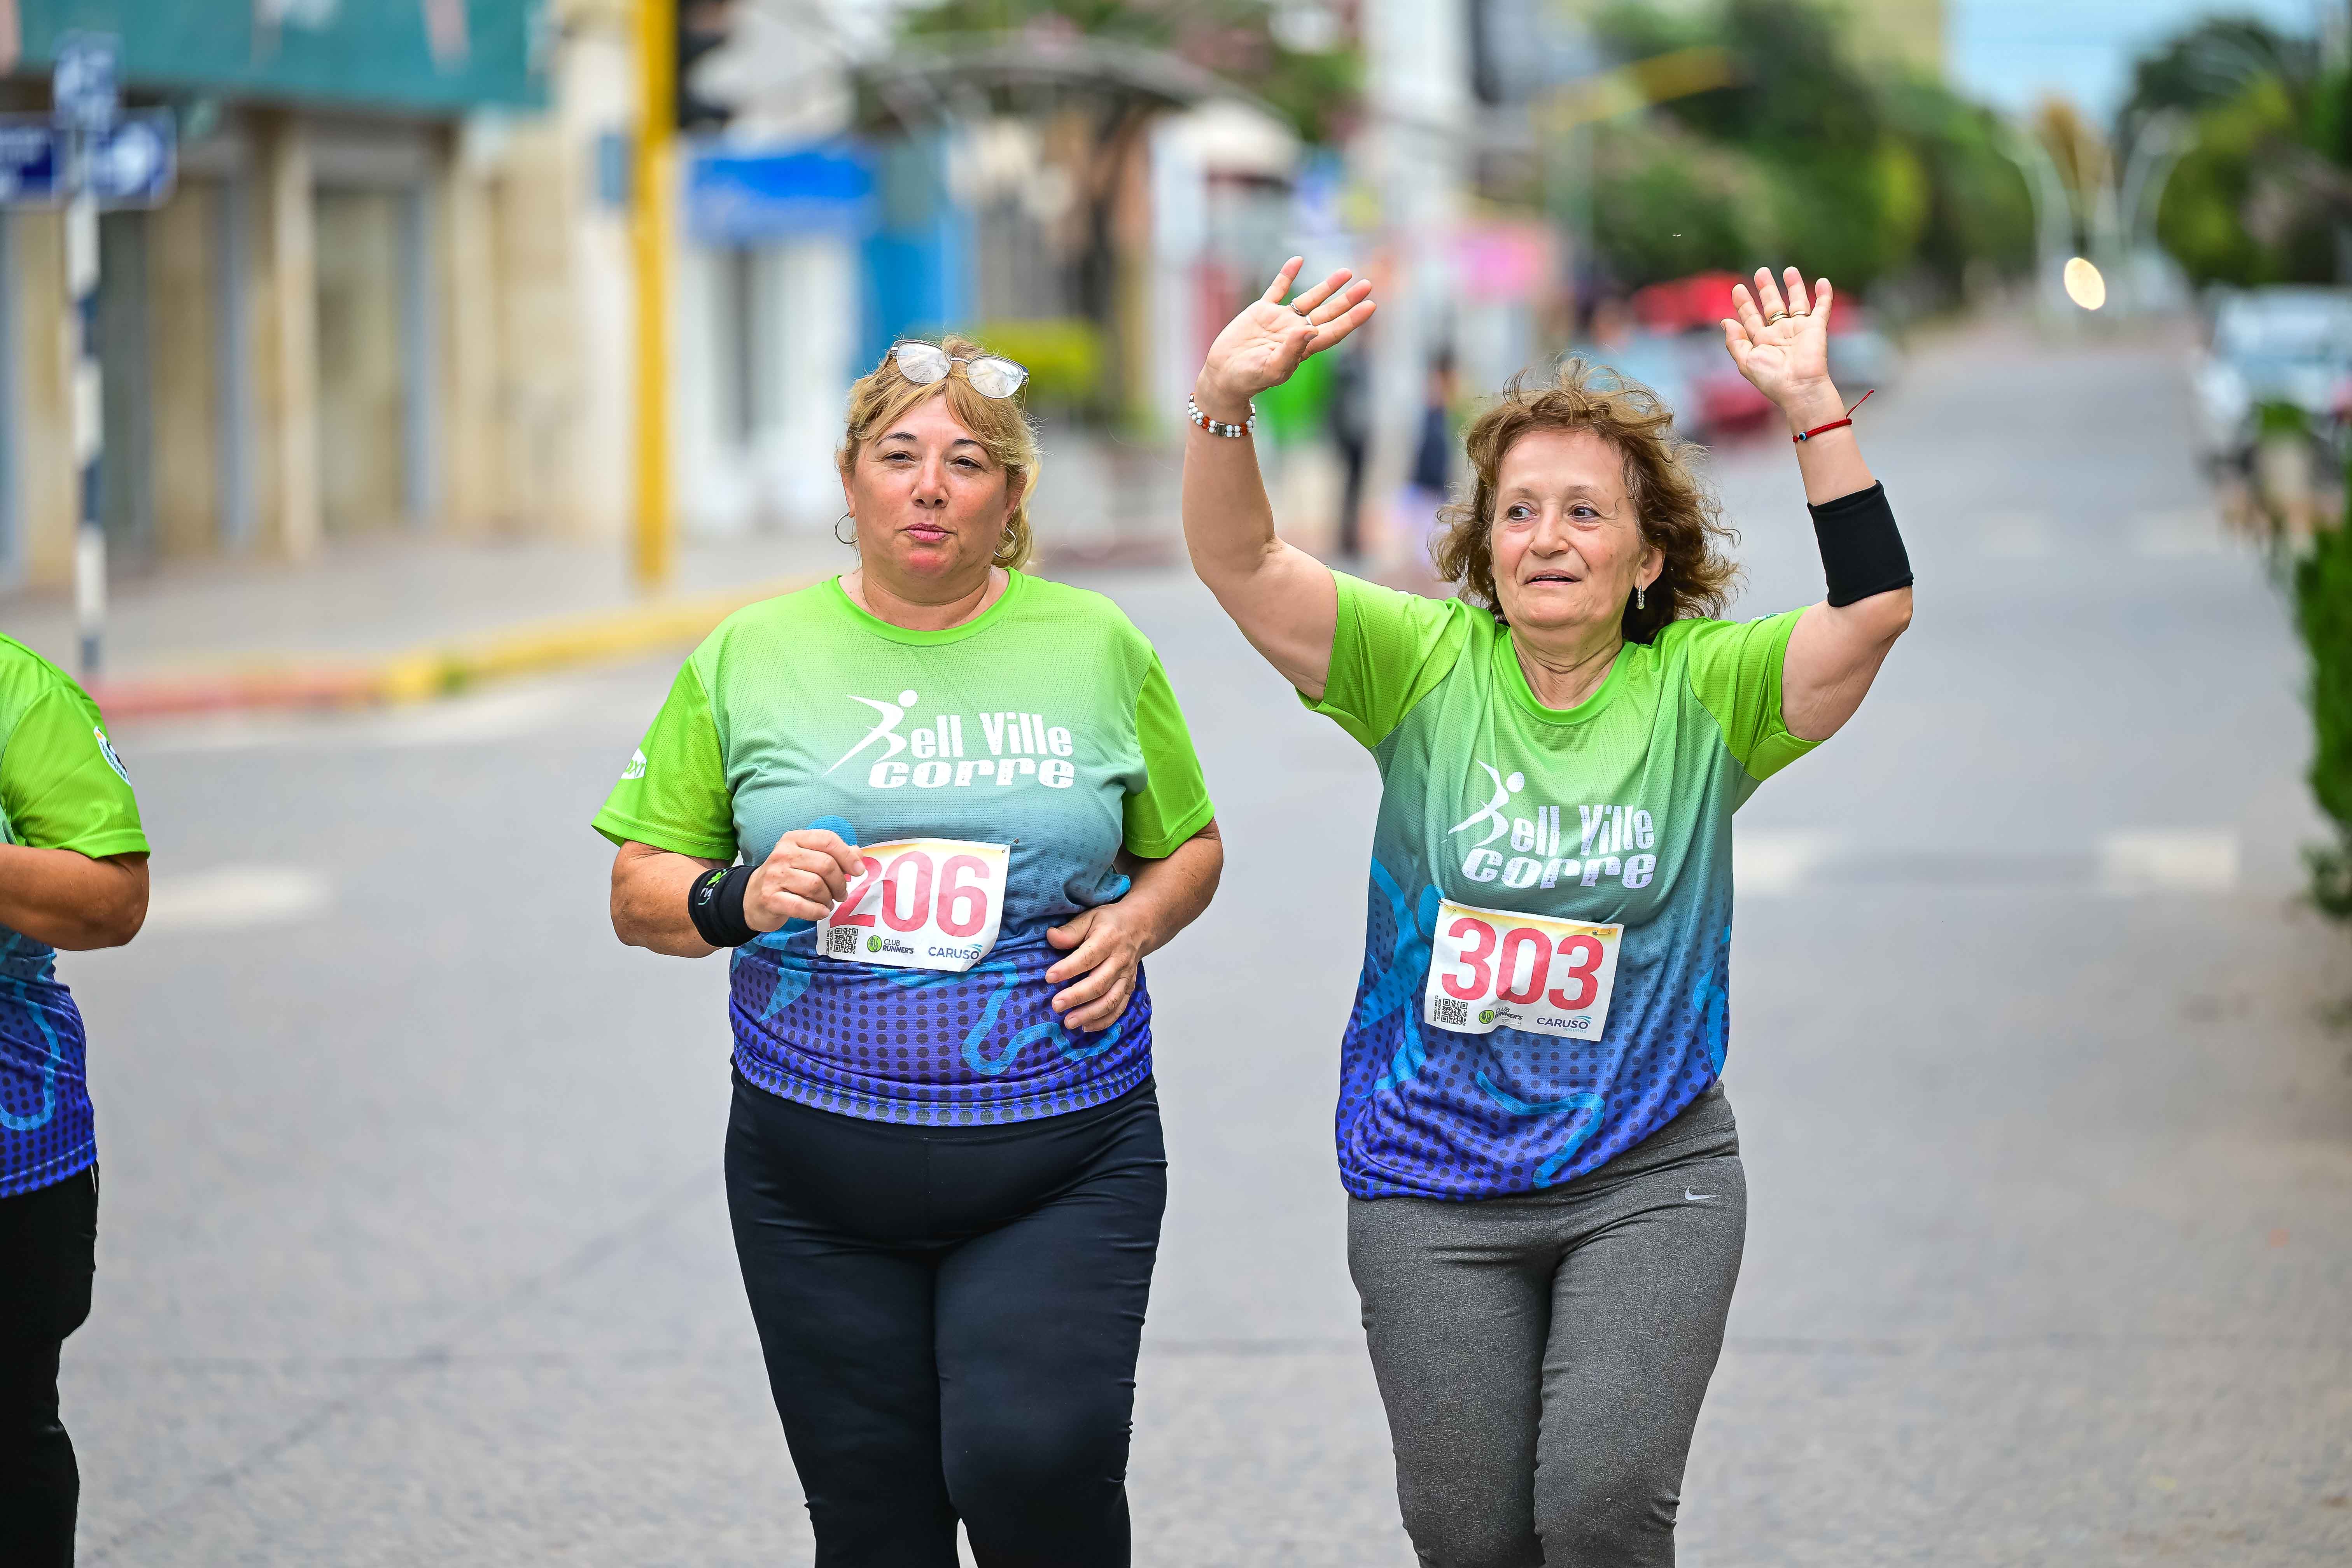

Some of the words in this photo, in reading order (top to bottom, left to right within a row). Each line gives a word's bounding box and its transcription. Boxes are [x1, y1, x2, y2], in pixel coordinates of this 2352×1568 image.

[979, 711, 1073, 757] Ville
[868, 757, 1075, 789] corre
[1578, 804, 1655, 856] Ville
[1461, 848, 1657, 889] corre
[829, 851, 990, 937] 206
[928, 947, 979, 959] CARUSO
[1442, 917, 1604, 1010] 303
[1536, 1017, 1588, 1029] CARUSO
